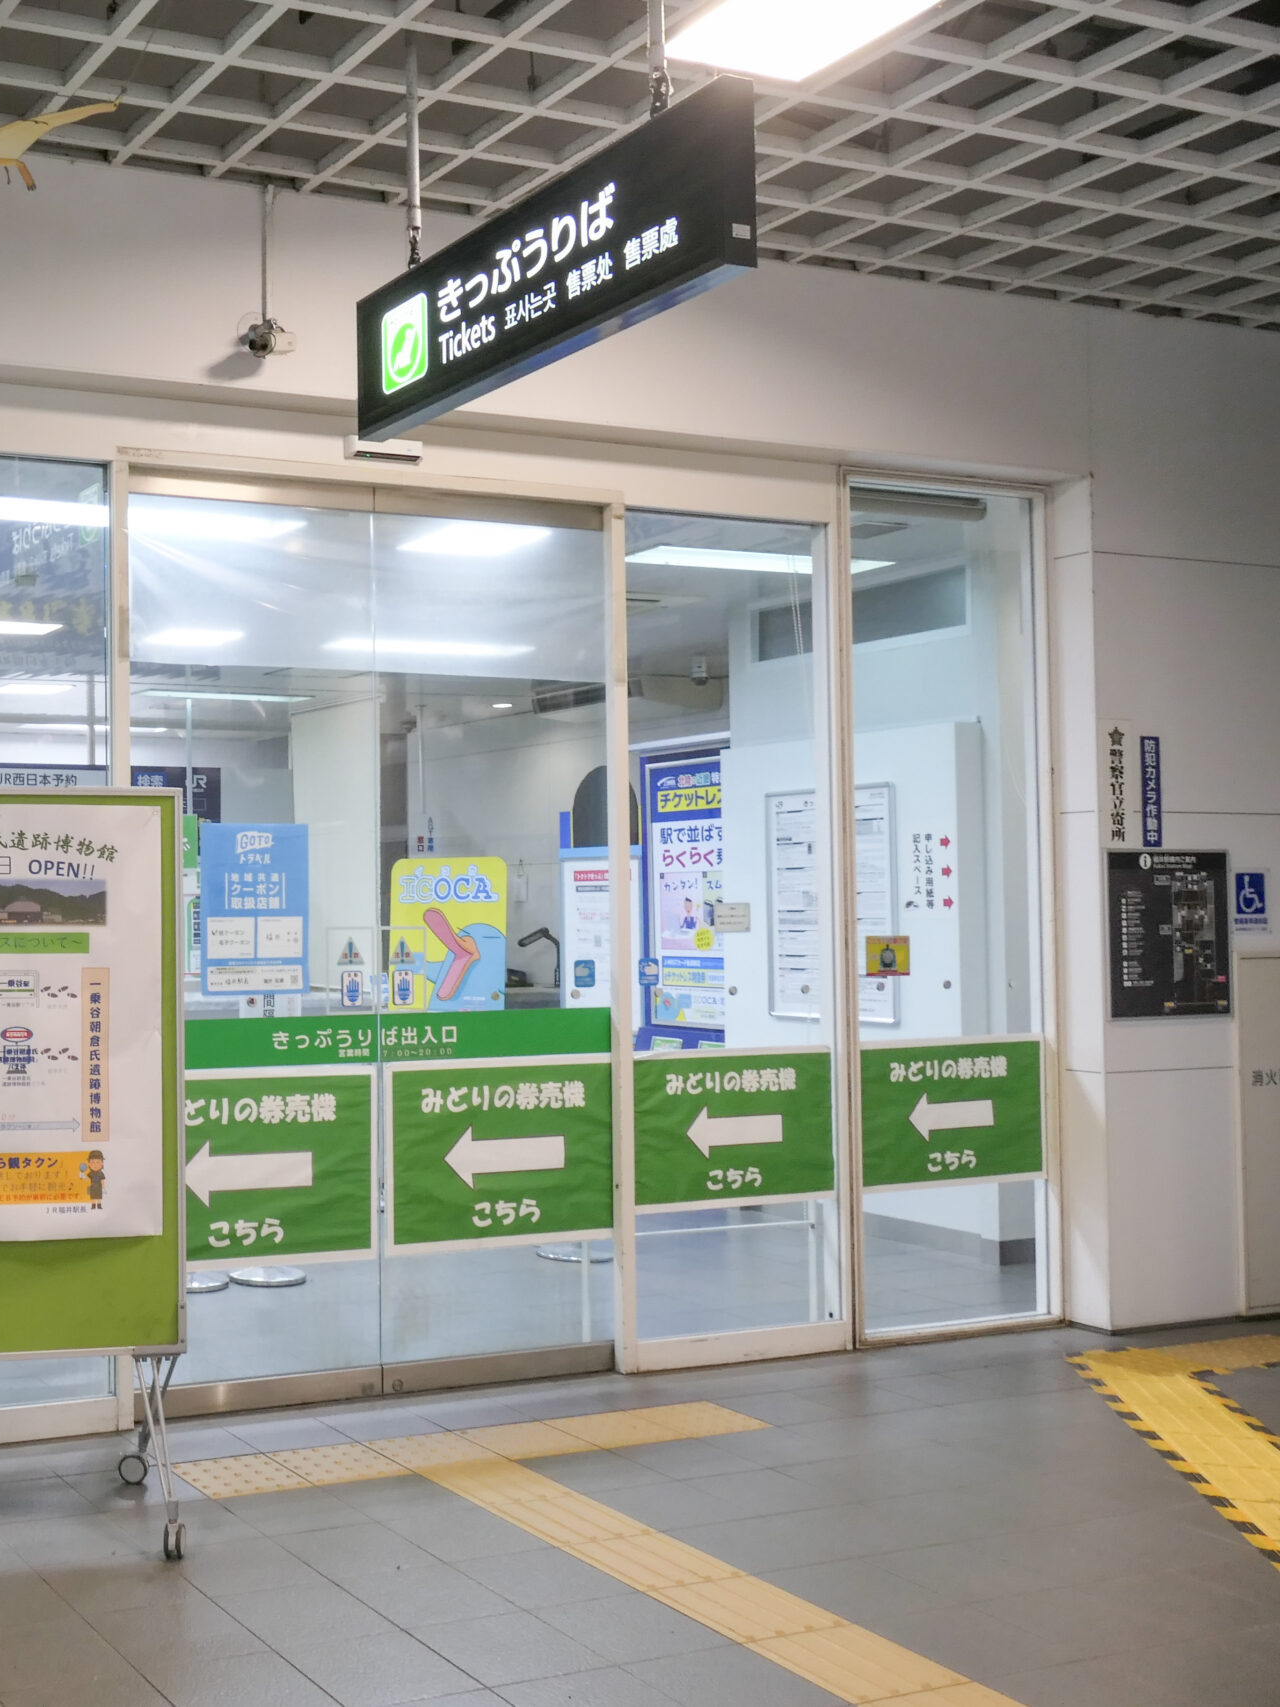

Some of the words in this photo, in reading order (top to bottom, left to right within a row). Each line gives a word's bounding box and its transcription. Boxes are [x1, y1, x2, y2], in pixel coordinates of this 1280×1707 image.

[437, 182, 616, 323] きっぷうりば
[624, 217, 679, 271] 售票處
[566, 252, 613, 301] 售票处
[504, 281, 557, 330] 표사는곳
[439, 313, 496, 364] Tickets
[137, 774, 164, 787] 検索
[1143, 739, 1158, 843] 防犯カメラ作動中
[1109, 749, 1126, 842] 警察官立寄所
[28, 859, 95, 880] OPEN!!
[239, 854, 271, 864] トラベル
[231, 884, 280, 895] クーポン
[401, 876, 493, 901] ICOCA
[272, 1025, 458, 1050] きっぷうりば出入口
[89, 981, 102, 1134] 一乗谷朝倉氏遺跡博物館
[1252, 1071, 1280, 1087] 消火
[927, 1149, 977, 1173] こちら
[706, 1167, 763, 1191] こちら
[471, 1198, 541, 1227] こちら
[208, 1216, 284, 1248] こちら
